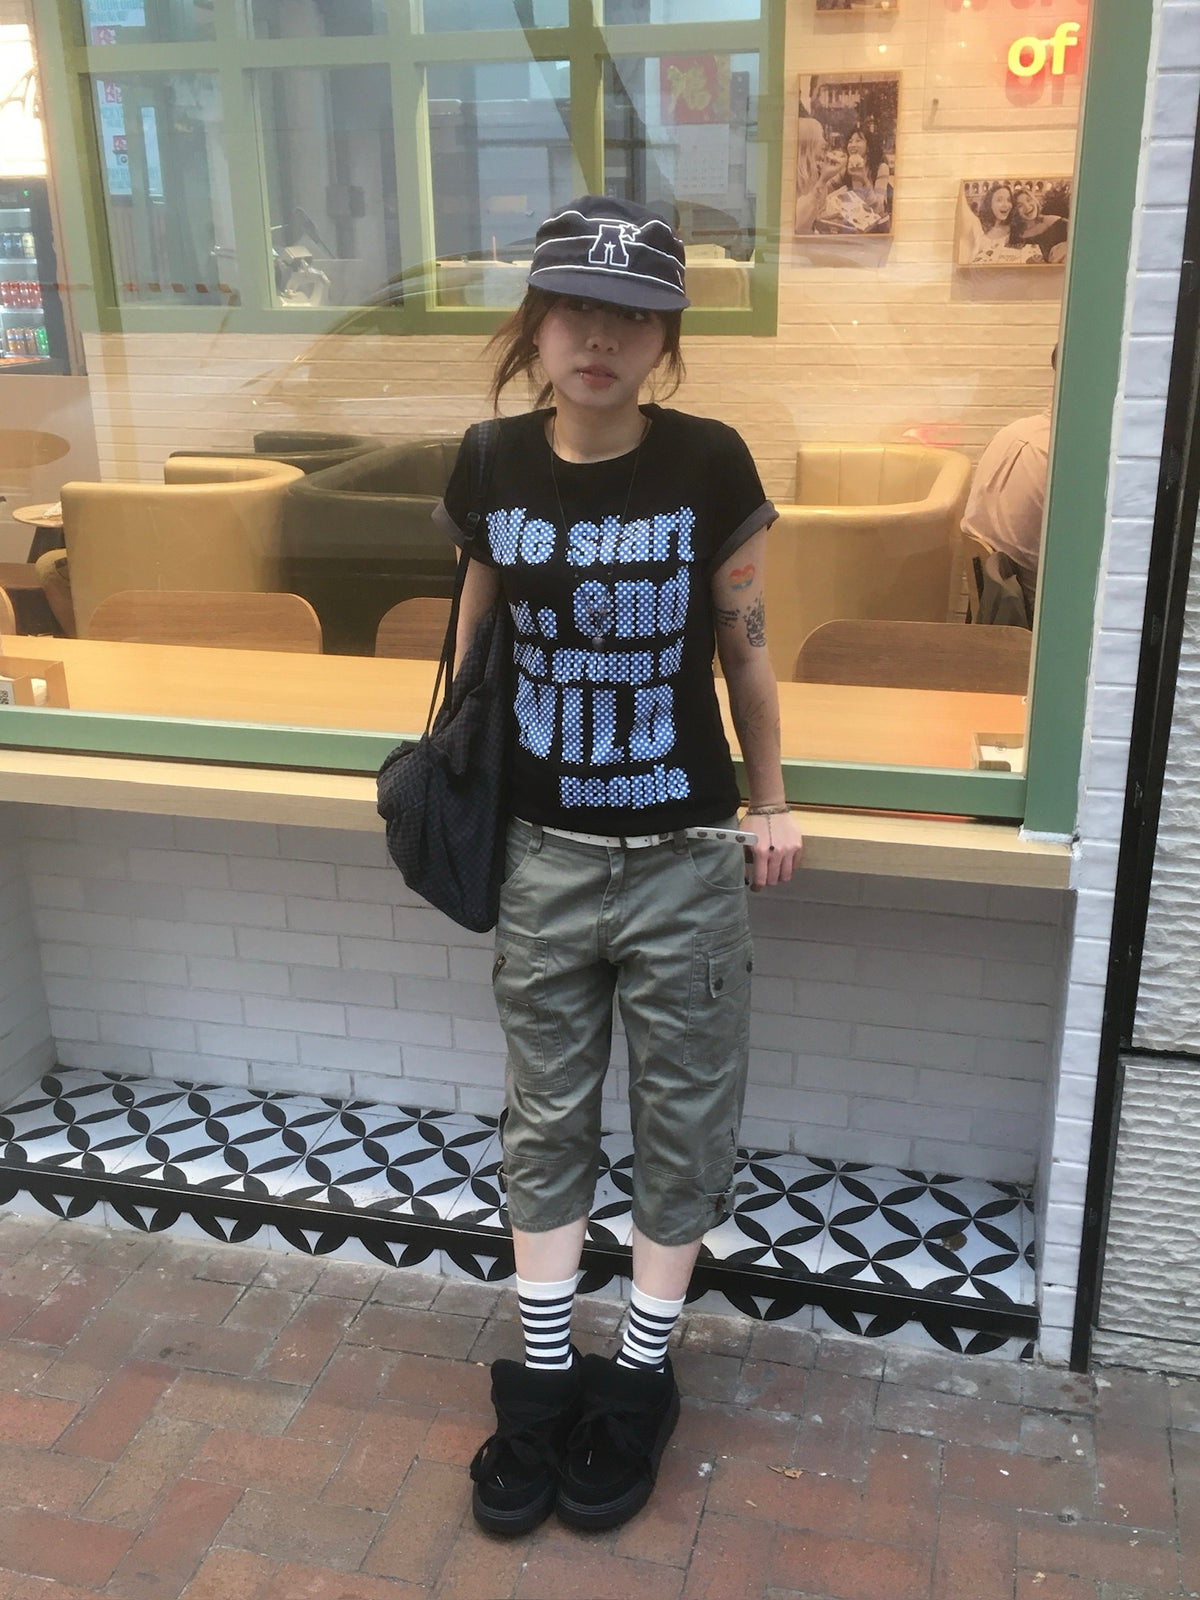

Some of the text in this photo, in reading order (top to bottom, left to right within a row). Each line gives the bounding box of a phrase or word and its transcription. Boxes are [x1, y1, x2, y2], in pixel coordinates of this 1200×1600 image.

[1007, 21, 1081, 77] of
[486, 505, 696, 568] We start
[572, 563, 691, 640] end
[551, 647, 655, 686] group
[513, 671, 678, 767] WILD
[558, 763, 691, 810] people
